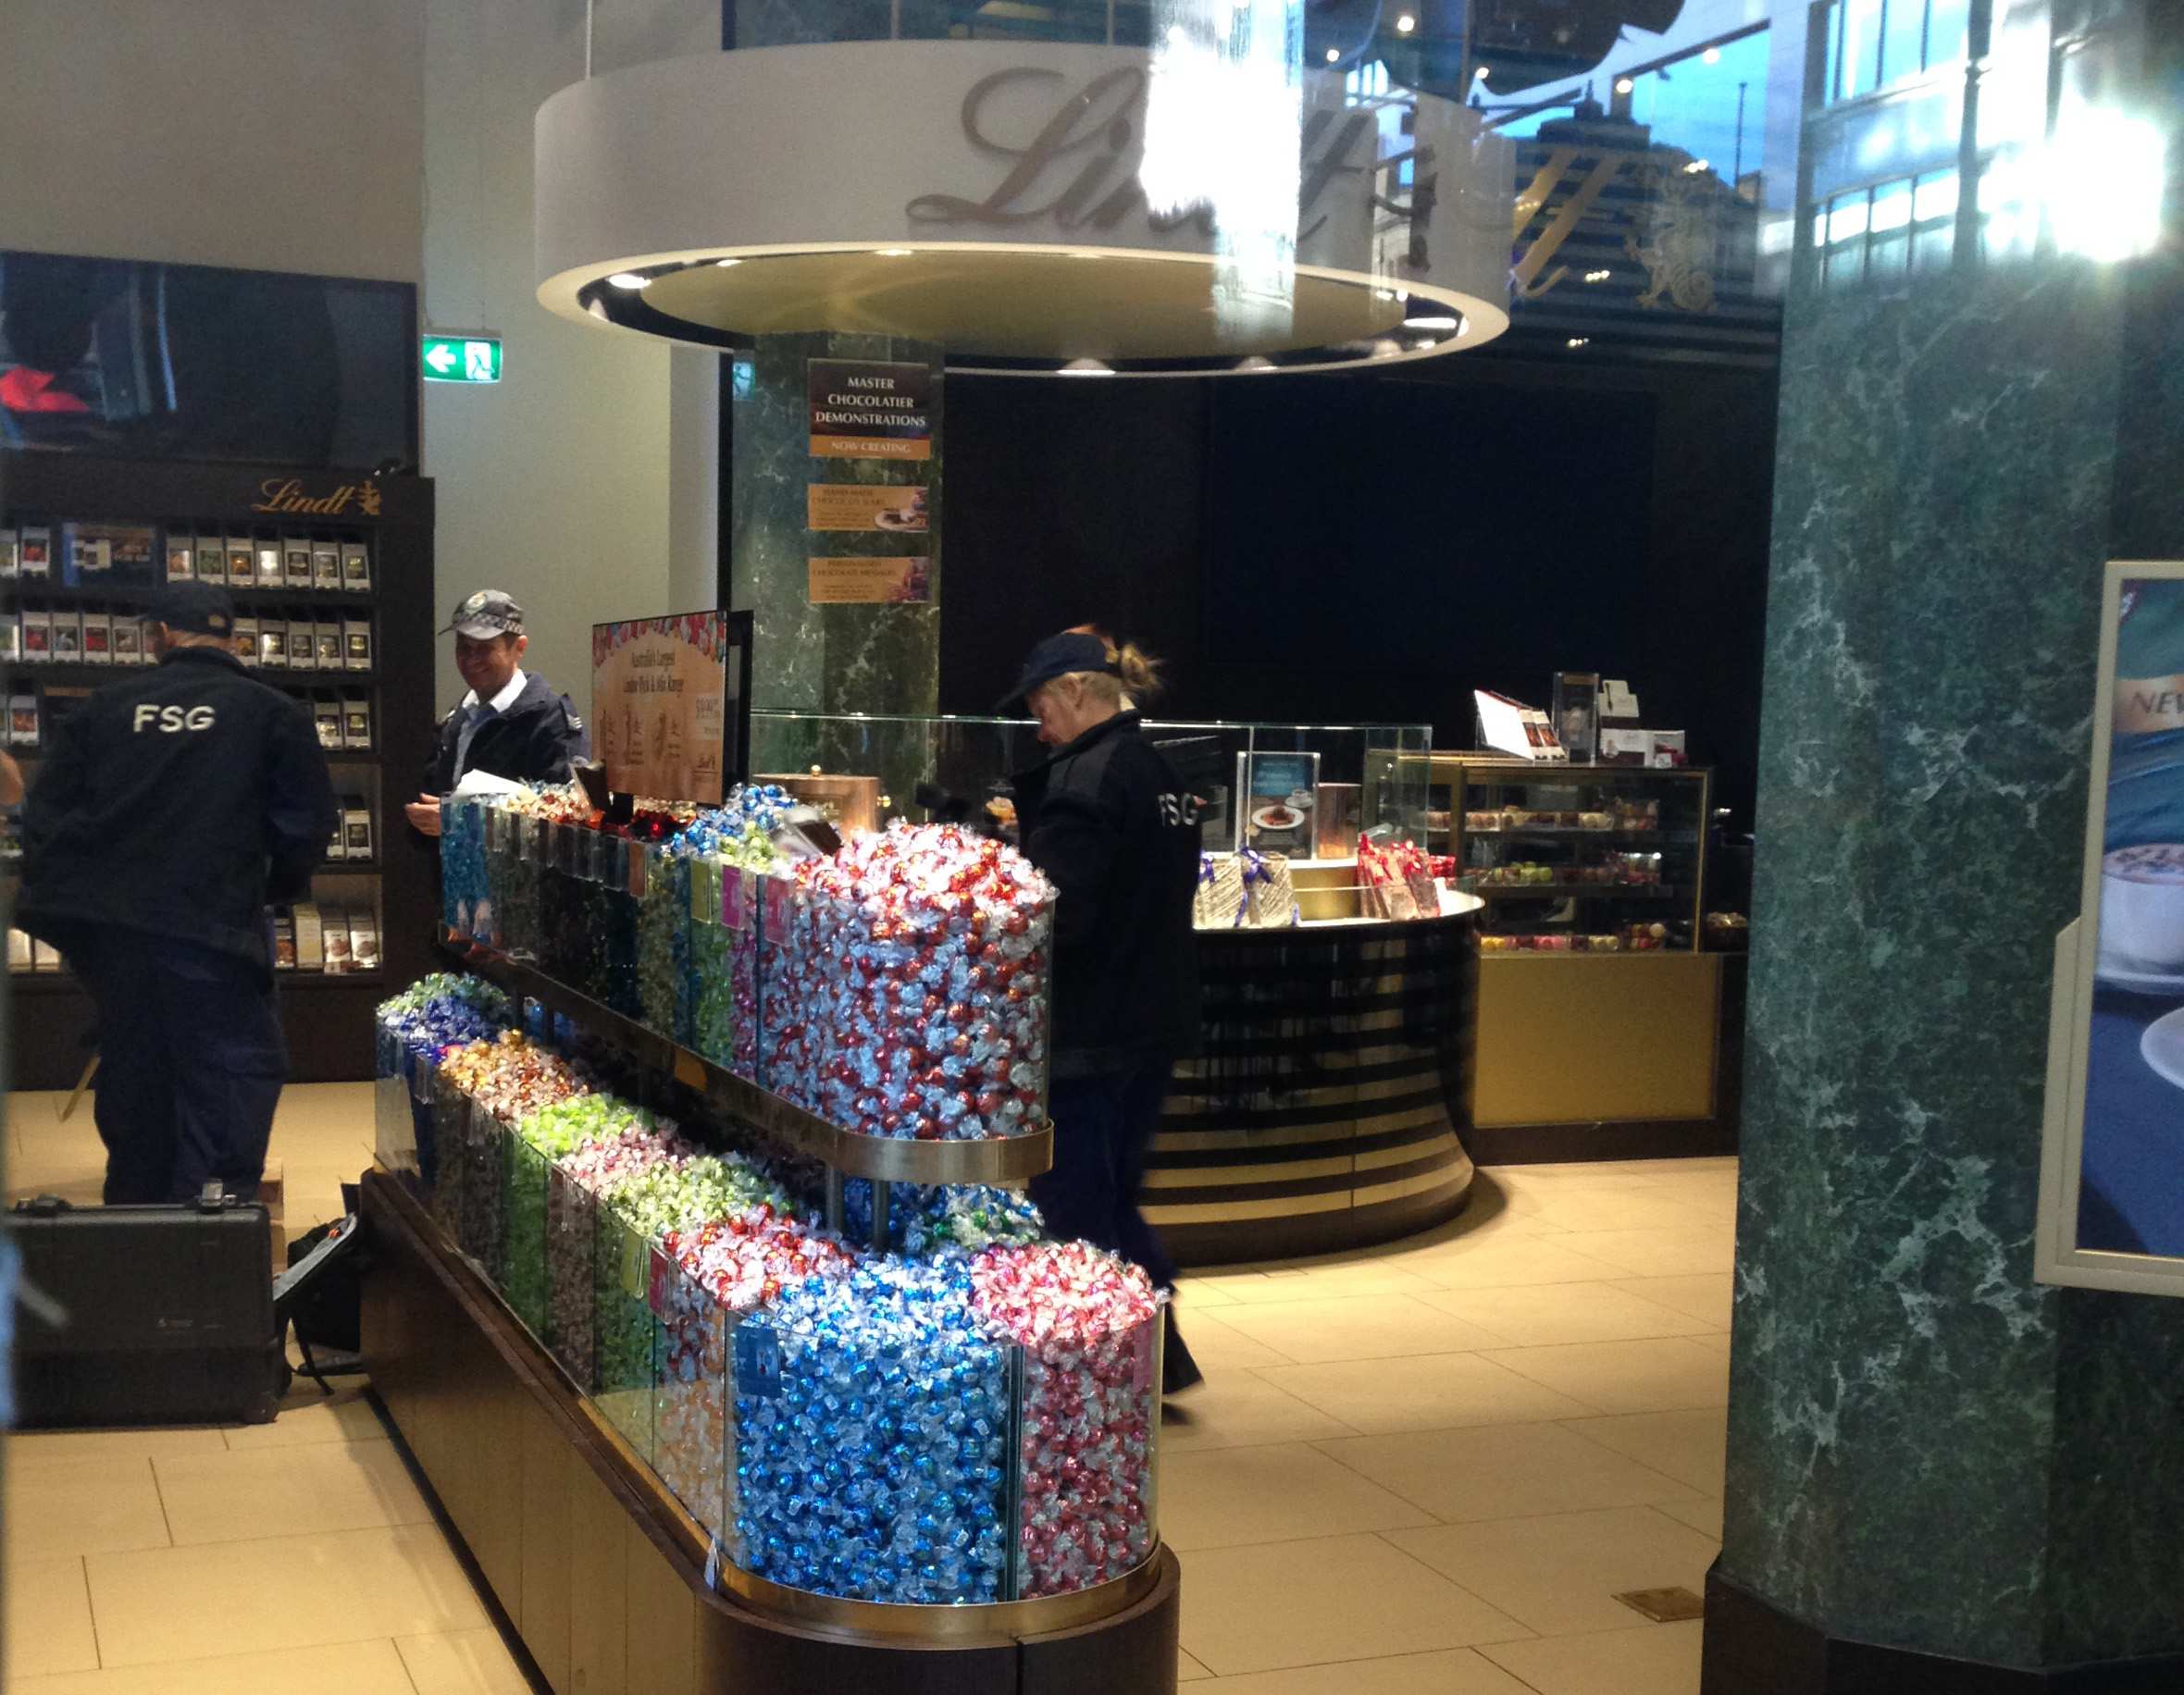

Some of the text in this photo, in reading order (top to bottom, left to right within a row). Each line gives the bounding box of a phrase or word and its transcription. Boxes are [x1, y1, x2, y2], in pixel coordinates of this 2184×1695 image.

[847, 377, 895, 390] MASTER
[827, 393, 914, 408] CHOCOLATIER
[815, 411, 926, 427] DEMONSTRATIONS
[830, 441, 912, 453] NOW CREATING
[251, 477, 355, 514] Lindt
[133, 703, 216, 734] FSG
[1157, 793, 1199, 828] FSG
